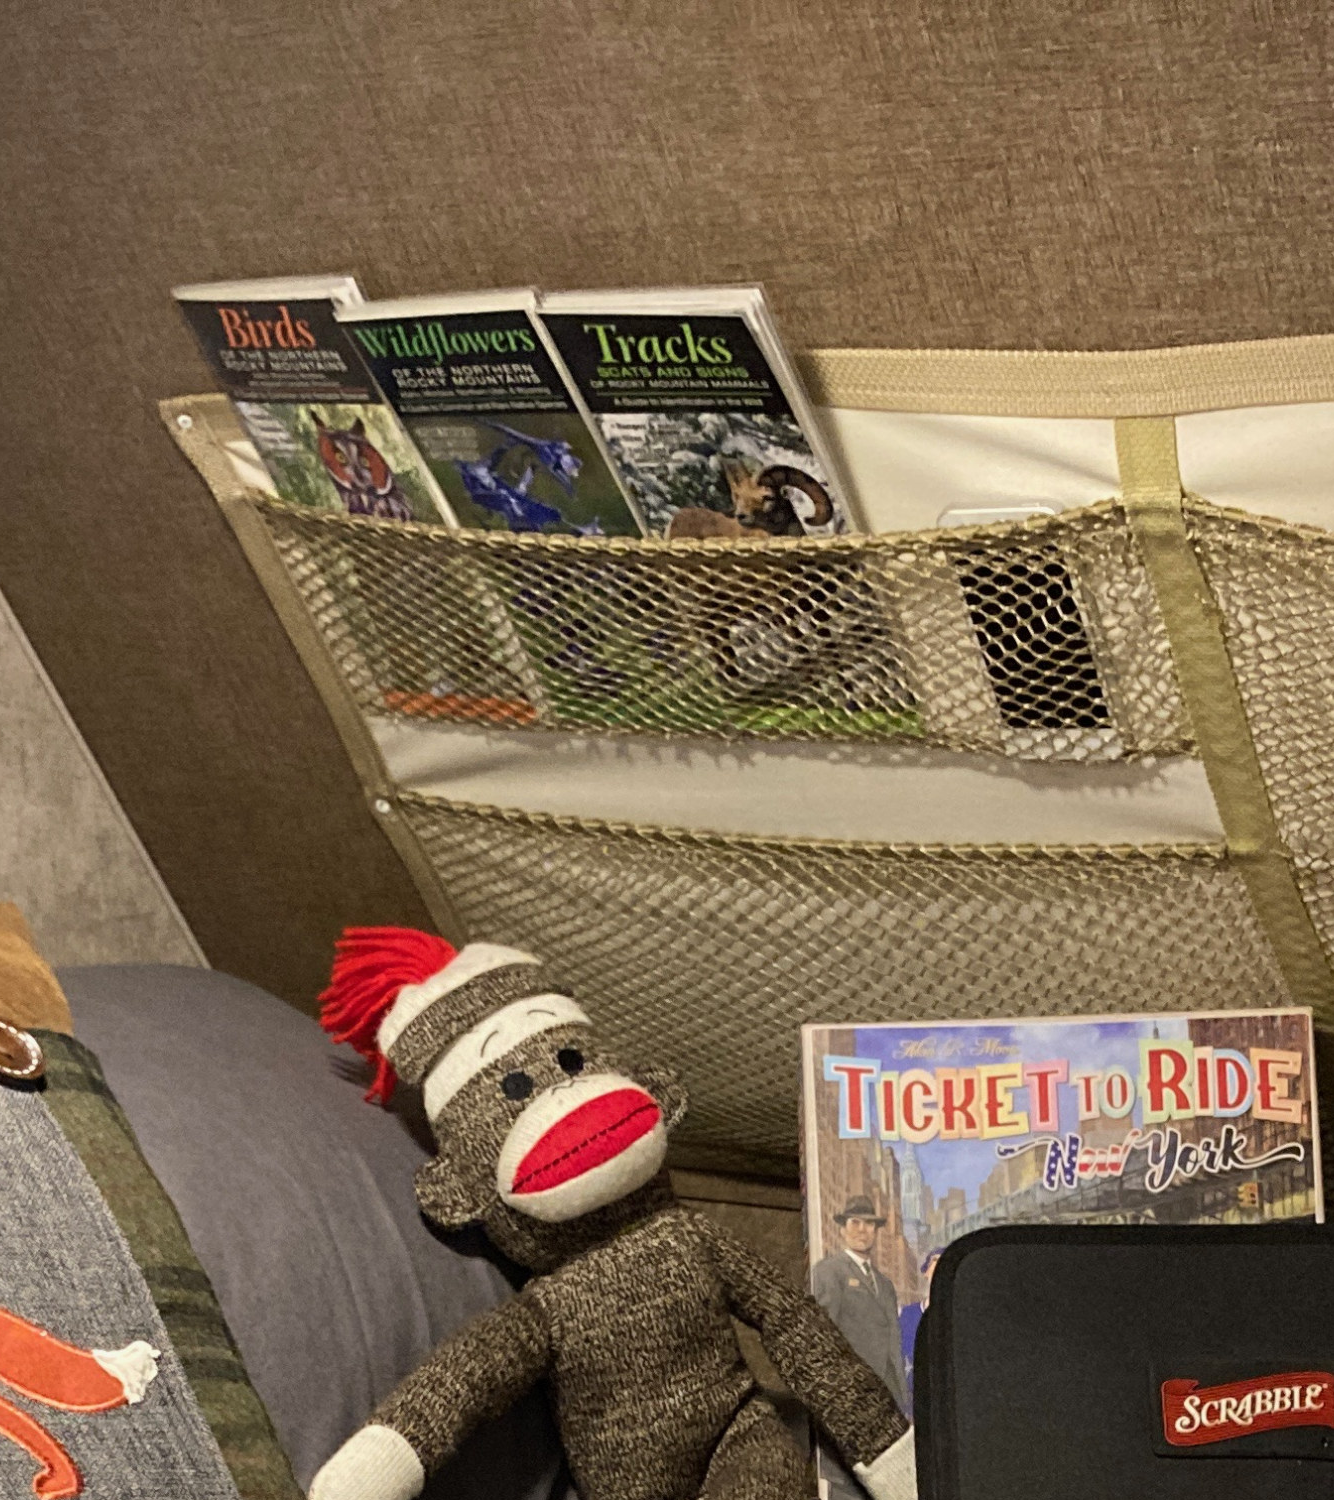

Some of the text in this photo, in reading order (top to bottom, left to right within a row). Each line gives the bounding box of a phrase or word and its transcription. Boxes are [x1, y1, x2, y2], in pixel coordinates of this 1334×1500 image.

[219, 305, 317, 348] Birds
[354, 321, 536, 366] Wildflowers
[583, 323, 733, 363] Tracks
[392, 363, 535, 378] OF THE NORTHERN
[396, 374, 541, 388] ROCKY MOUNTAINS
[597, 366, 749, 378] SCATS AND SIGNS
[827, 1044, 1299, 1140] TICKET TO RIDE
[999, 1125, 1304, 1192] New York
[1175, 1383, 1324, 1434] SCRABBLE
